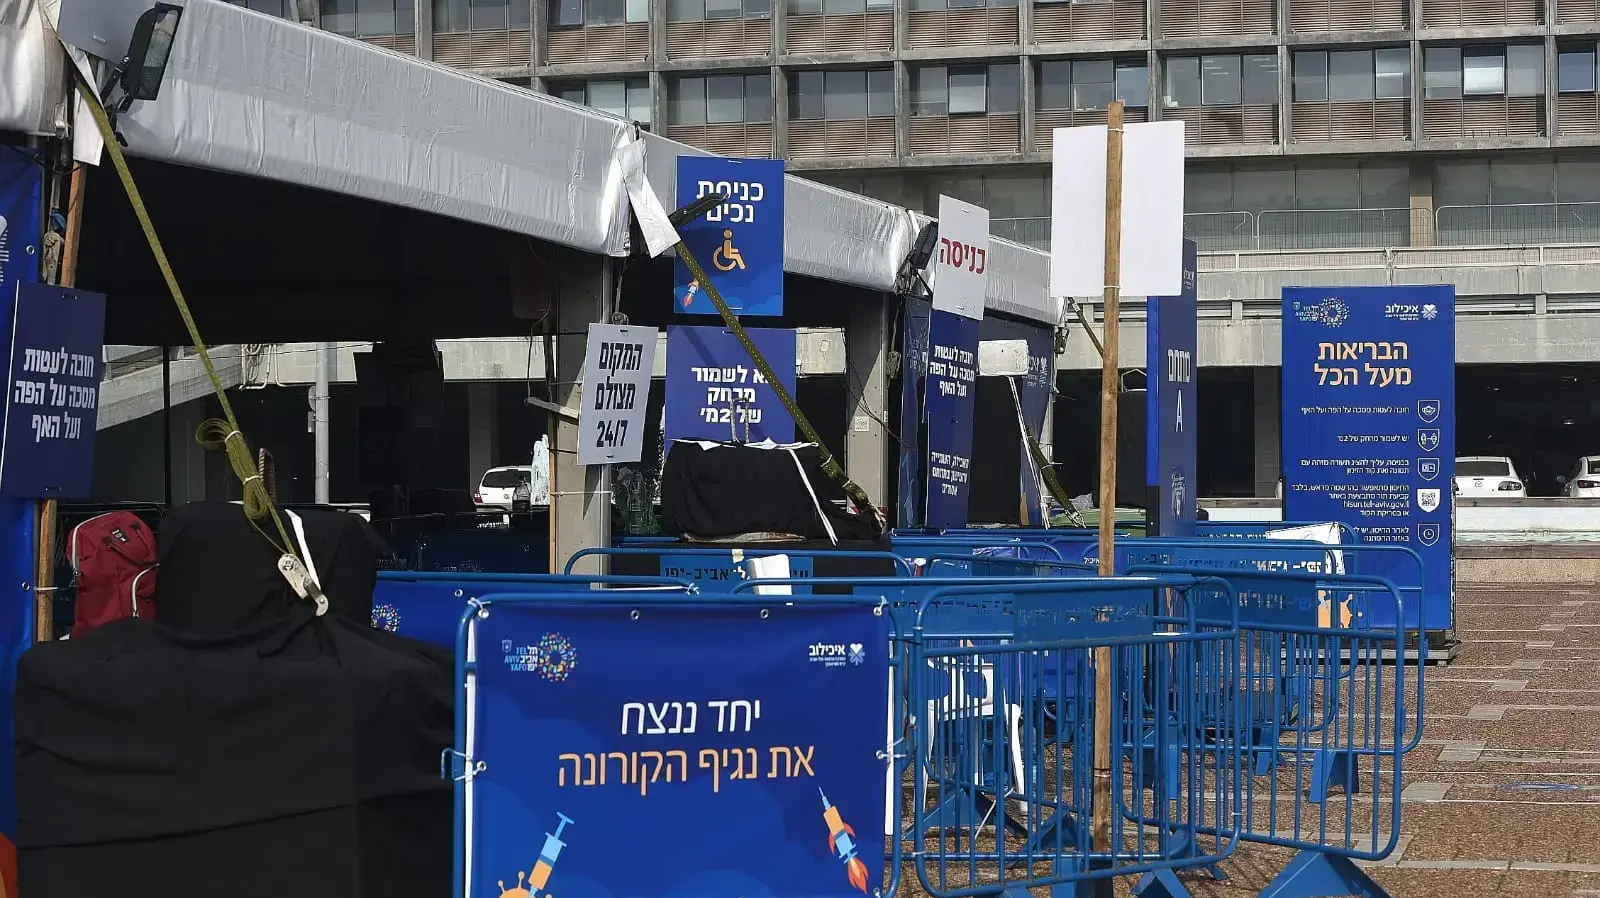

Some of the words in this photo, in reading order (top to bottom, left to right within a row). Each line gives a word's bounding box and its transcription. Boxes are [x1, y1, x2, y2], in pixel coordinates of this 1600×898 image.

[696, 180, 764, 201] כניסת
[939, 236, 986, 275] כניסה
[1384, 303, 1419, 314] איכילוב
[24, 347, 68, 375] לעטות
[599, 341, 643, 377] המקום
[934, 345, 959, 362] לעטות
[959, 350, 974, 365] חובה
[1317, 342, 1408, 360] הבריאות
[70, 353, 95, 378] חובה
[691, 364, 748, 384] לשמור
[752, 368, 769, 384] א
[929, 361, 947, 377] הפה
[948, 361, 959, 379] על
[959, 367, 975, 383] מסכה
[1314, 362, 1359, 386] הכל
[1364, 362, 1412, 388] מעל
[14, 380, 45, 405] הפה
[50, 378, 67, 406] על
[69, 385, 96, 409] מסכה
[595, 375, 636, 410] מצולם
[707, 387, 756, 406] מרחק
[939, 380, 956, 397] האף
[957, 380, 967, 398] ועל
[735, 405, 762, 424] של
[1175, 389, 1183, 433] A
[31, 413, 60, 443] האף
[64, 411, 81, 440] ועל
[596, 419, 629, 448] 24/7
[808, 641, 846, 656] איכילוב
[621, 701, 697, 736] ננצח
[708, 699, 760, 733] יחד
[557, 748, 687, 796] הקורונה
[698, 746, 758, 793] נגיף
[767, 744, 816, 778] את
